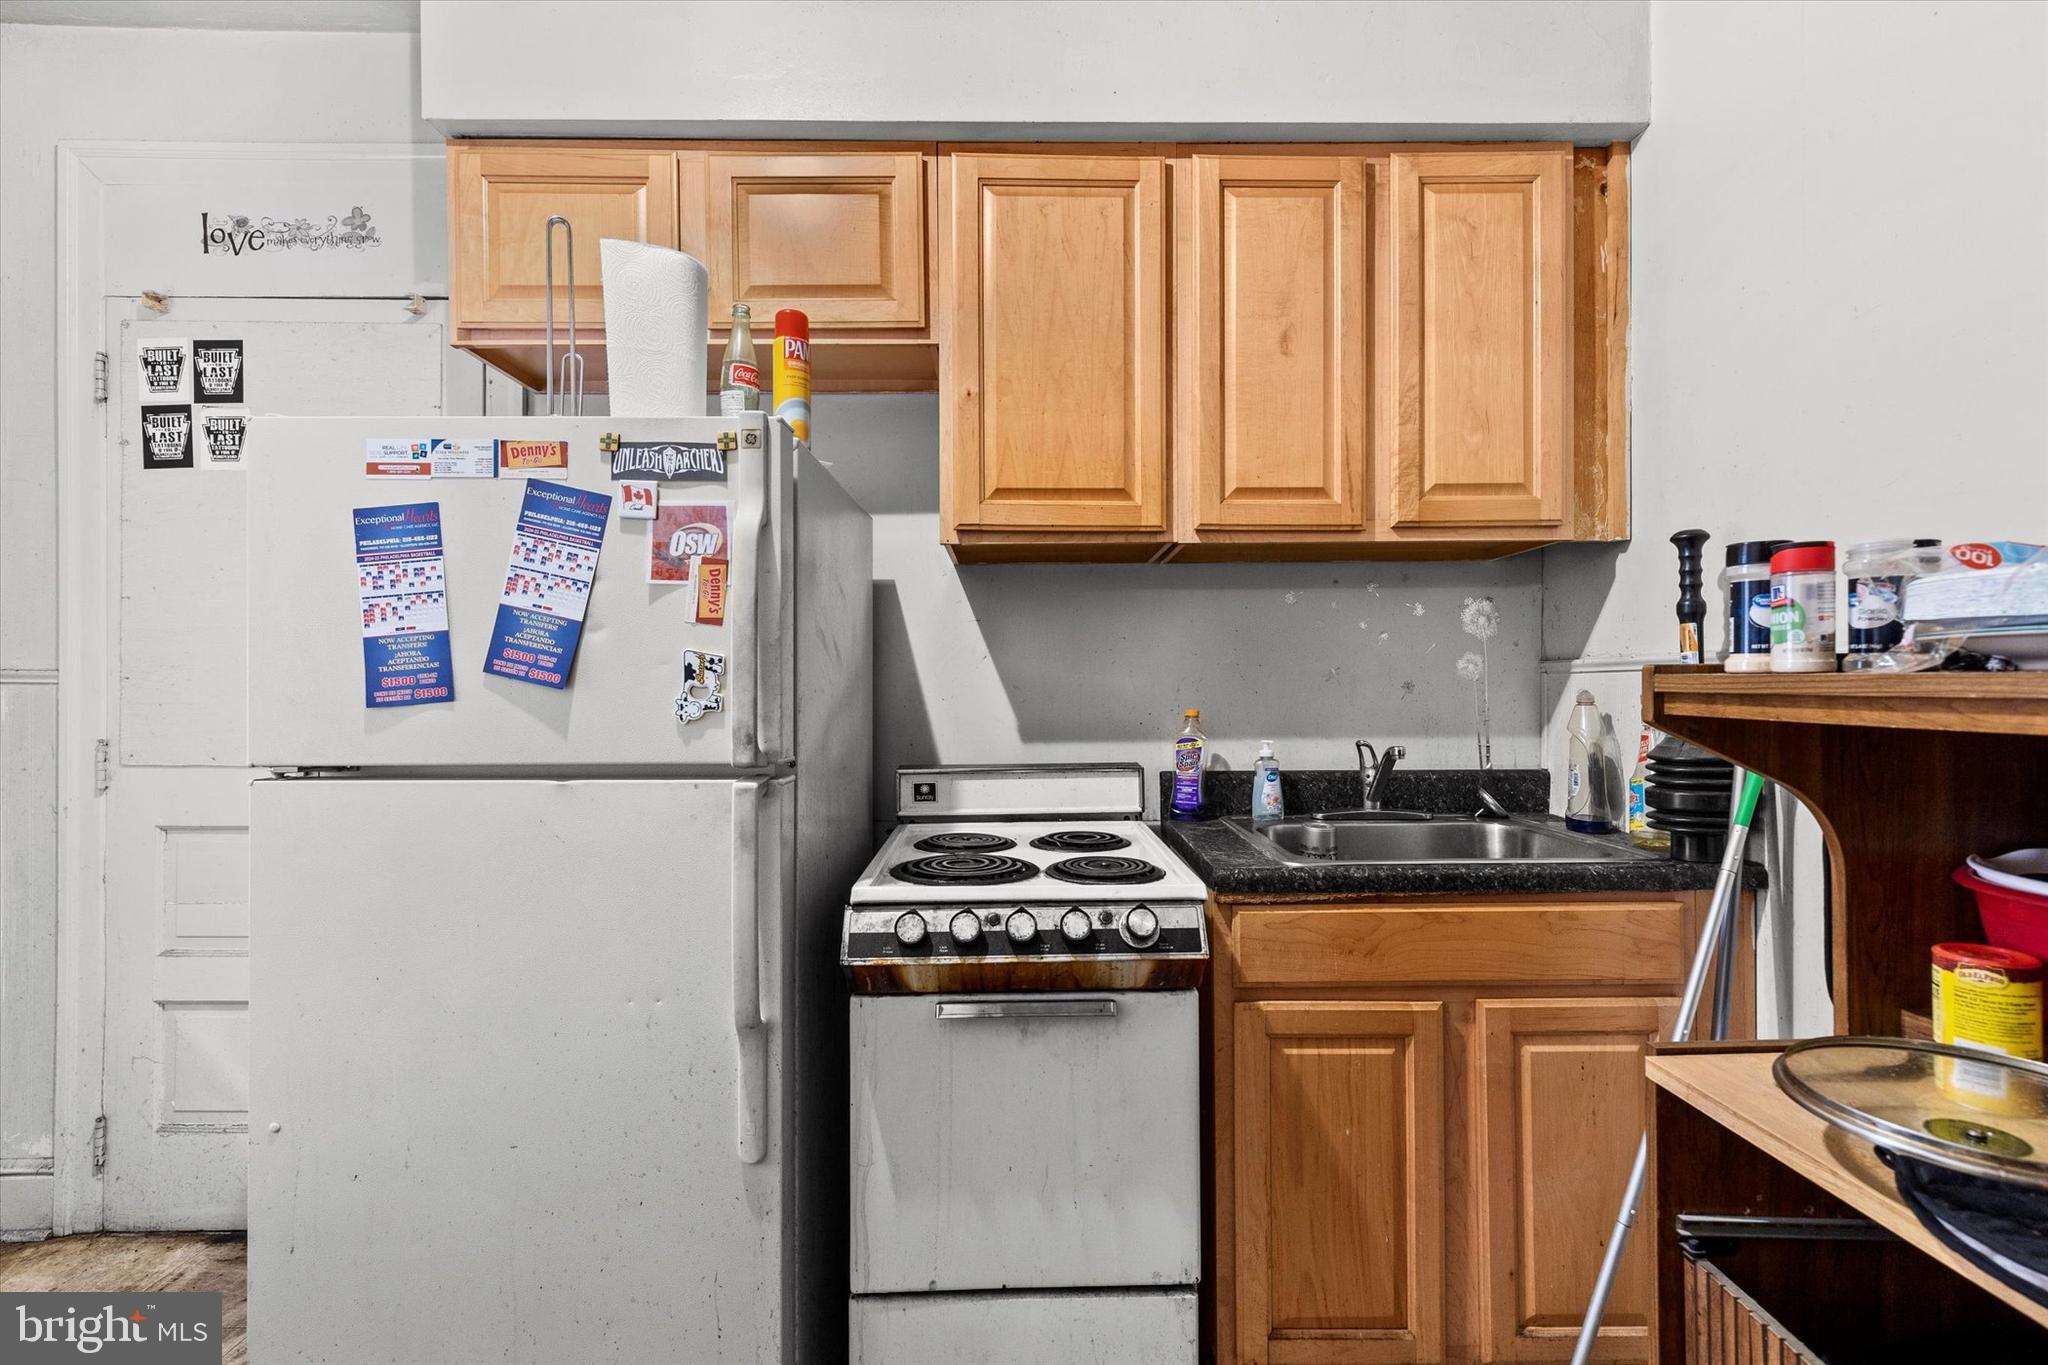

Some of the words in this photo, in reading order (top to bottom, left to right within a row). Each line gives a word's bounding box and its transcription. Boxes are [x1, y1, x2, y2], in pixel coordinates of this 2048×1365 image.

[201, 212, 264, 256] love
[147, 349, 179, 362] BUILT
[203, 351, 233, 363] BUILT
[147, 364, 179, 376] LAST
[203, 366, 233, 378] LAST
[152, 416, 182, 429] BUILT
[209, 419, 241, 431] BUILT
[152, 431, 182, 443] LAST
[209, 434, 240, 445] LAST
[510, 443, 557, 459] Denny's
[613, 447, 662, 474] UNLEASH
[527, 487, 576, 504] Exceptional
[355, 512, 405, 526] Exceptional
[669, 531, 719, 557] OSW
[709, 568, 722, 614] Denny's
[512, 609, 529, 618] NOW
[529, 613, 567, 626] ACCEPTING
[396, 634, 435, 643] ACCEPTING
[514, 632, 556, 645] ACEPTANDO
[387, 656, 429, 665] ACEPTANDO
[503, 648, 536, 663] $1500
[381, 675, 416, 688] $1500
[528, 668, 561, 684] $1500
[415, 687, 448, 699] $1500
